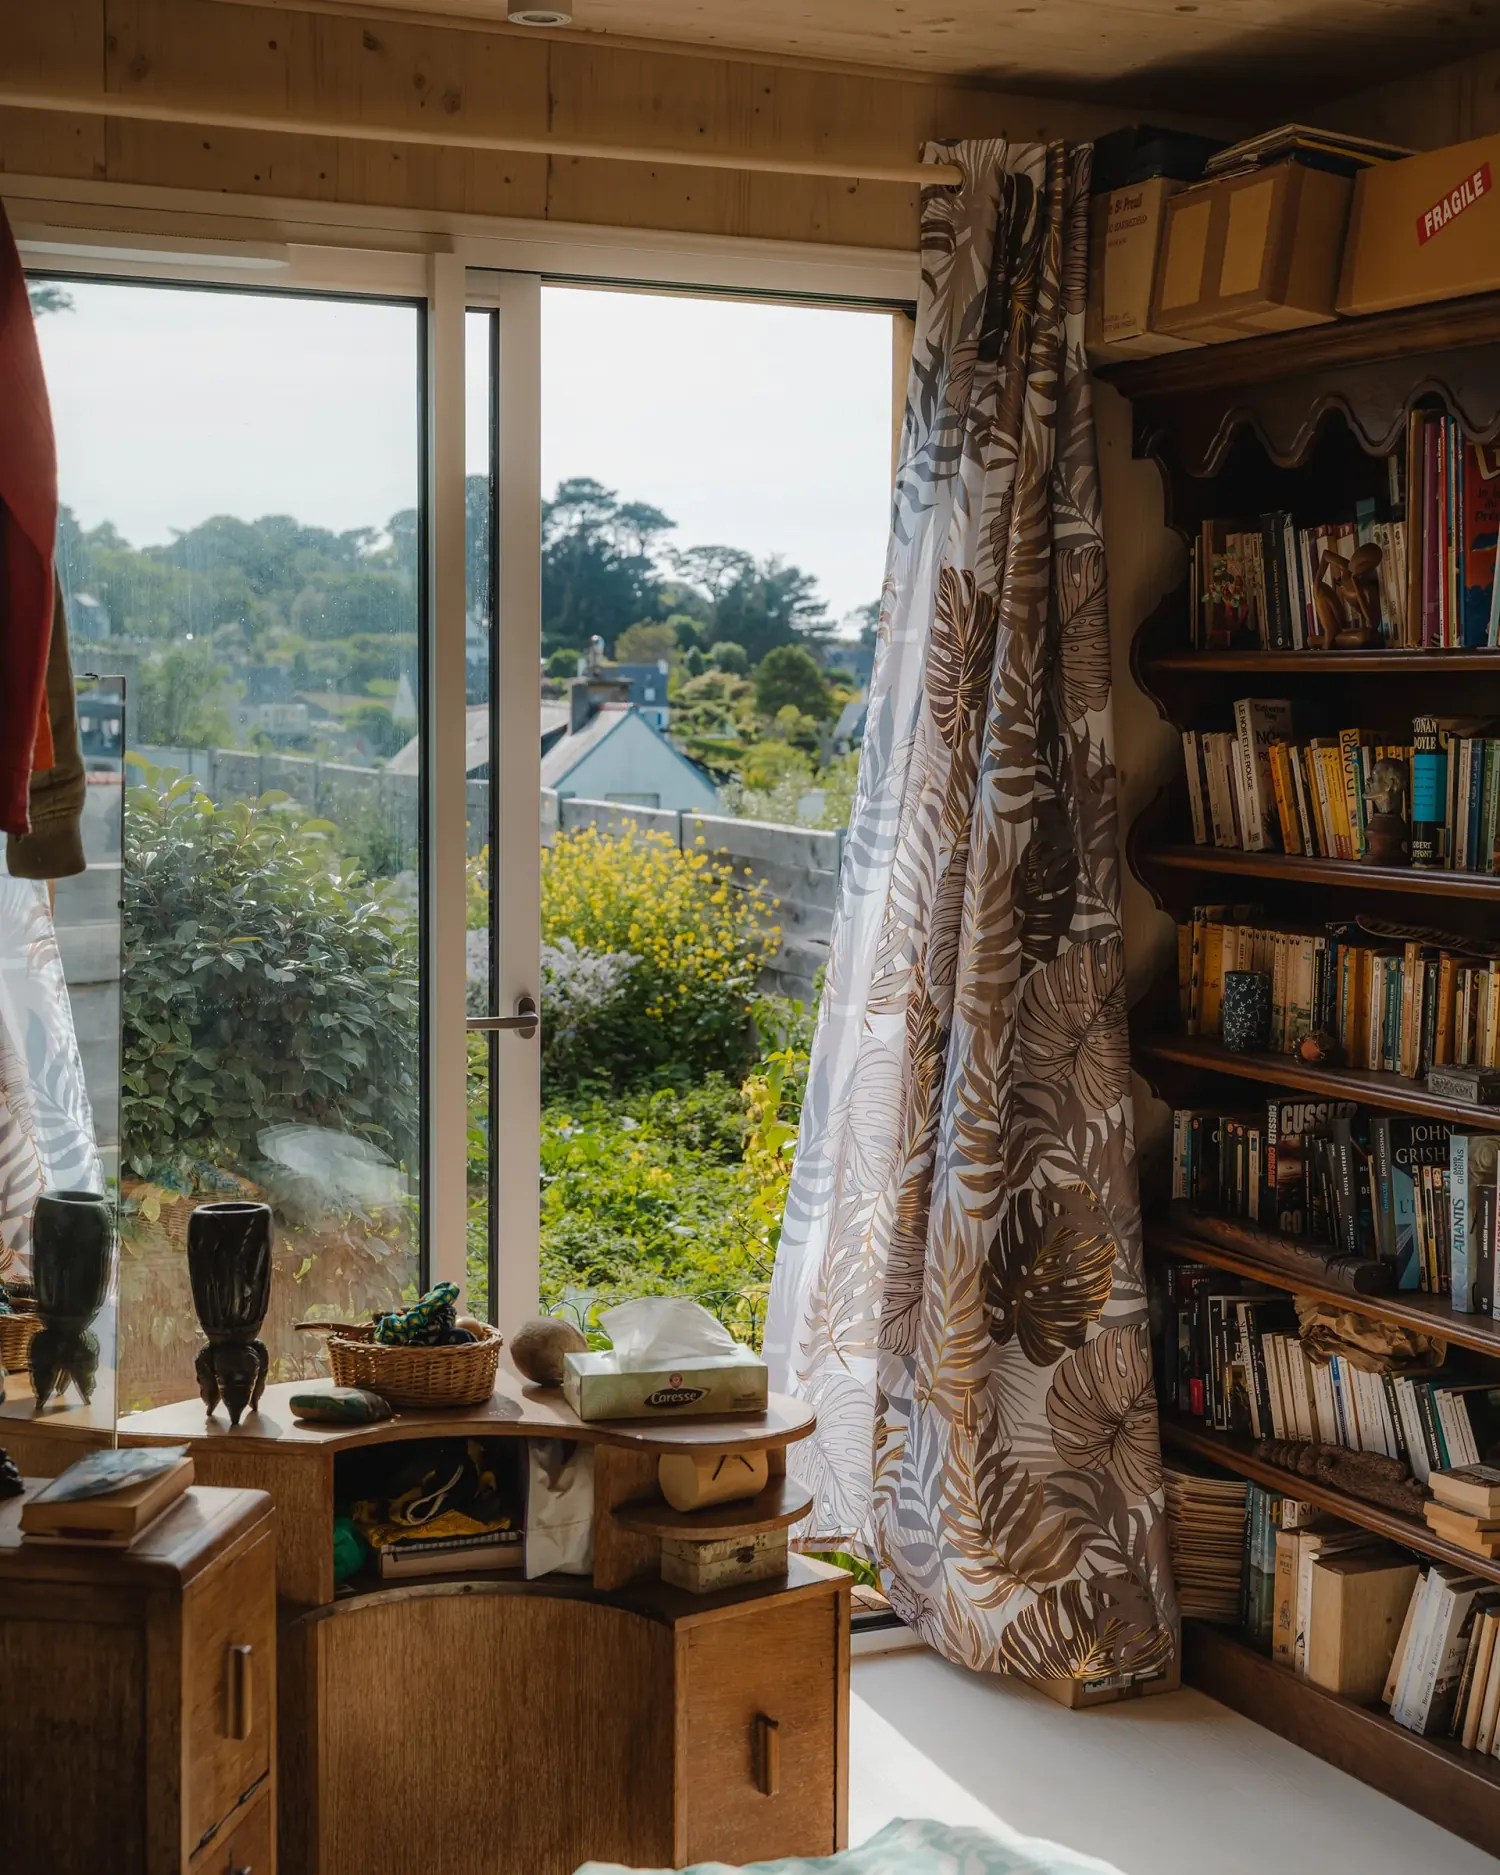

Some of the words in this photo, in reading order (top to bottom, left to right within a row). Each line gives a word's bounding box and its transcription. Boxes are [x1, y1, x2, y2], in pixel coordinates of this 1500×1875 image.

[1424, 171, 1484, 238] FRAGILE
[1238, 704, 1246, 716] LE
[1240, 716, 1248, 737] NOIR
[1242, 737, 1249, 748] ET
[1413, 736, 1437, 750] DOYLE
[1244, 749, 1251, 761] LE
[1245, 761, 1254, 791] ROUGE
[1412, 841, 1432, 849] OBERT
[1412, 850, 1433, 858] AFFONT
[1267, 1105, 1277, 1145] CUSSLER
[1281, 1103, 1358, 1134] CUSSLER
[1409, 1124, 1456, 1146] JOHN
[1267, 1146, 1276, 1189] CORSAIRE
[1340, 1145, 1349, 1175] INTERDIT
[1395, 1147, 1446, 1165] GRISH
[1457, 1148, 1465, 1185] GIBBINS
[1280, 1210, 1302, 1234] CO
[1452, 1198, 1465, 1255] ATLANTIS
[1239, 1320, 1248, 1340] JFK
[1243, 1344, 1251, 1381] GARRISON
[651, 1391, 697, 1404] Caresse
[1393, 1414, 1403, 1441] TREMAYNE
[1430, 1433, 1440, 1461] TREMAYNE
